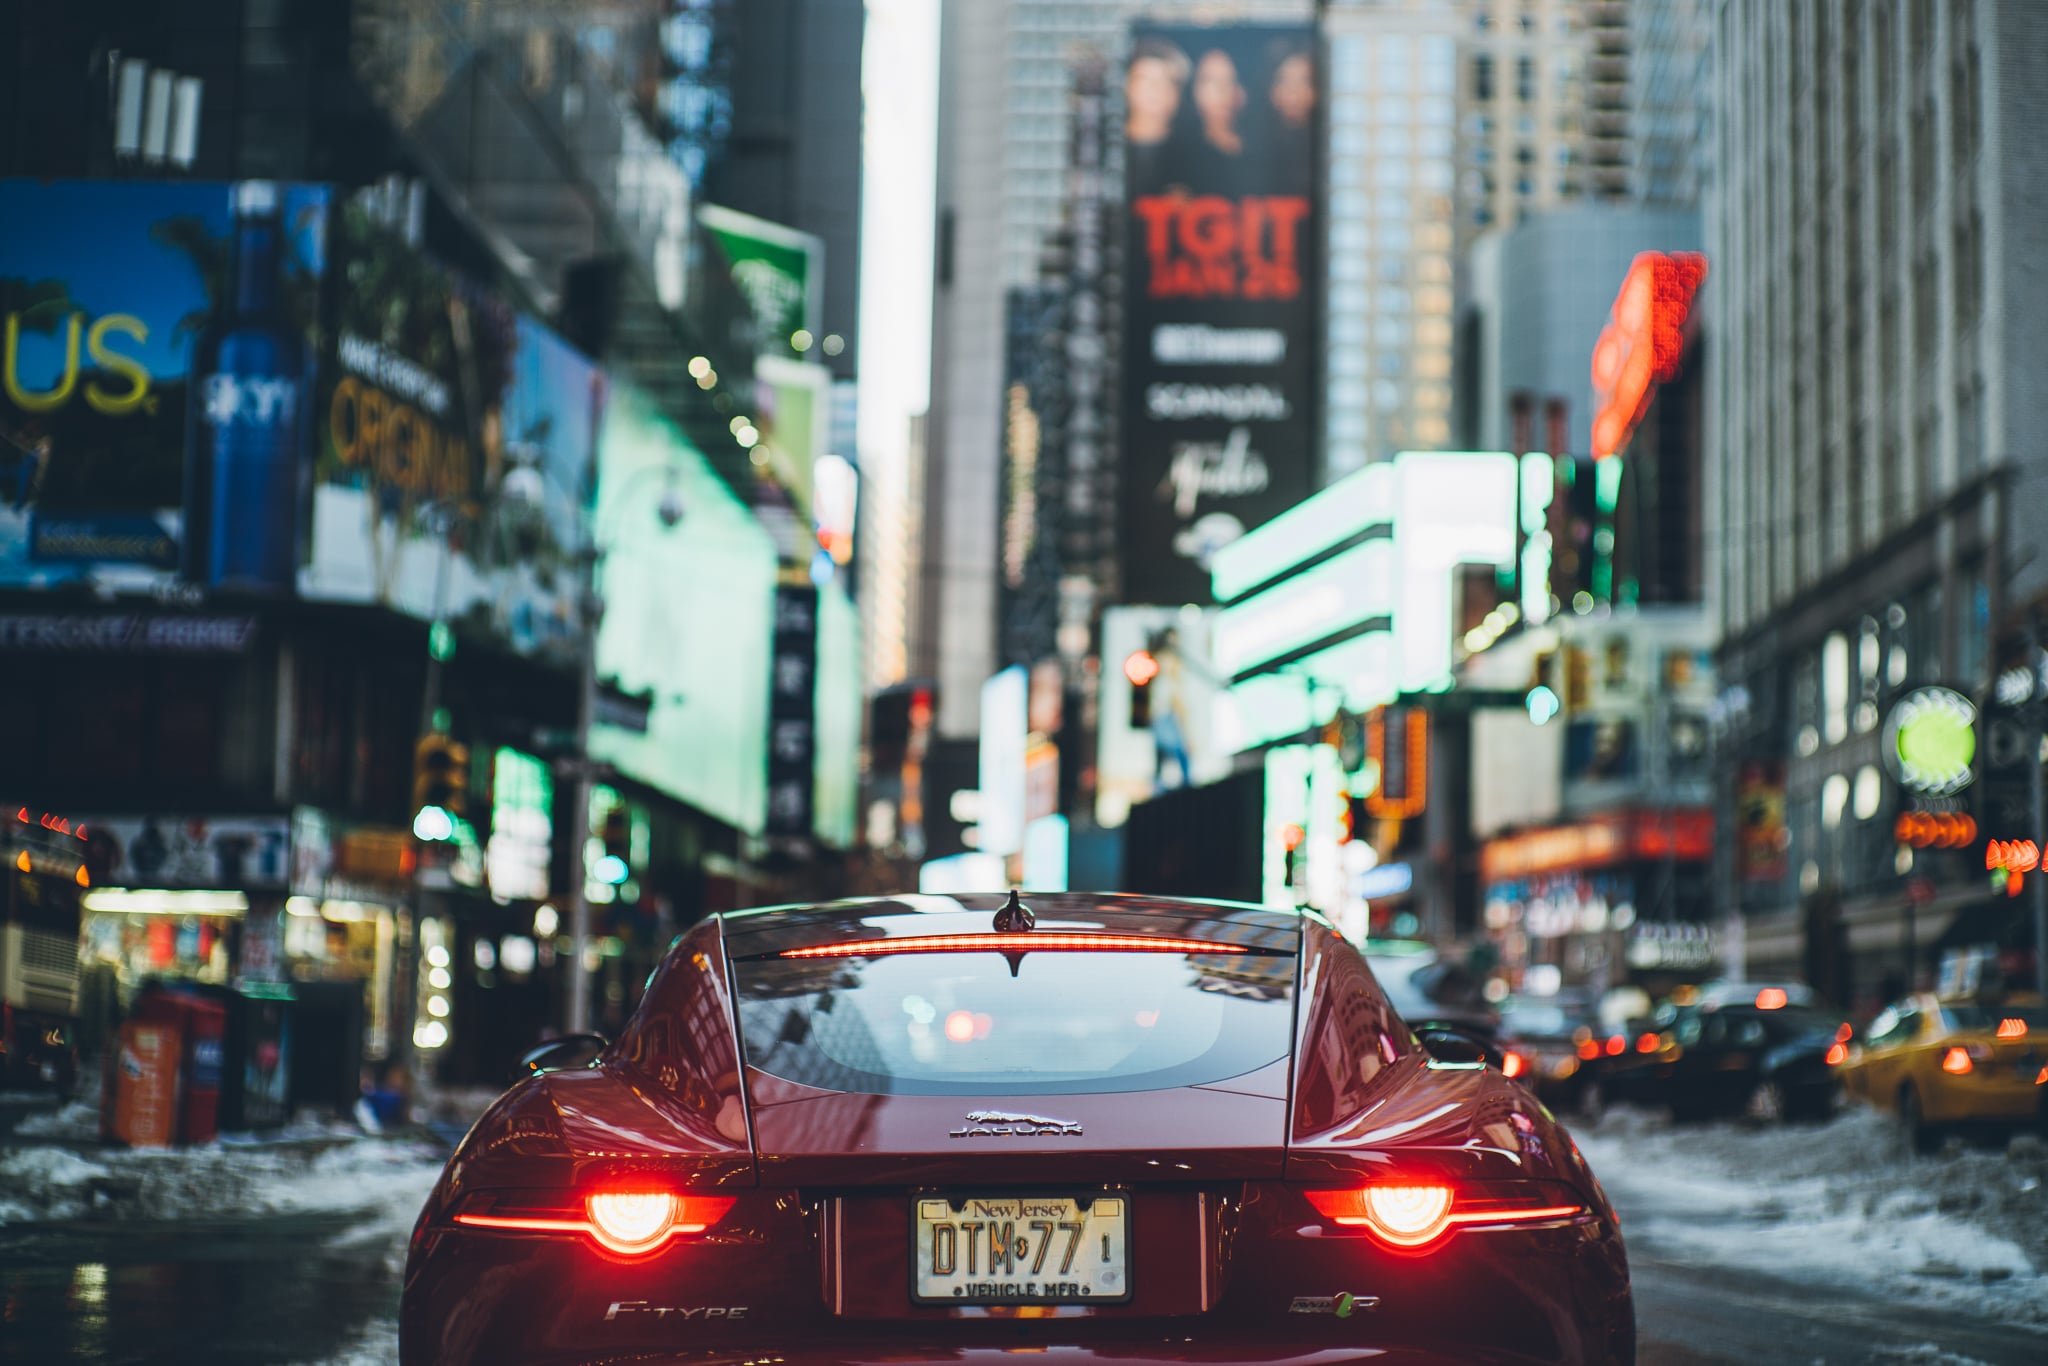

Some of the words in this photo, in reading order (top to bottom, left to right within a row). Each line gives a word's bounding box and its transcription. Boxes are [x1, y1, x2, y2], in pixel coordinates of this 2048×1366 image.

[949, 1126, 1083, 1138] JAGUAR
[973, 1201, 1012, 1218] New
[1015, 1201, 1068, 1220] Jersey
[966, 1283, 1035, 1297] VEHICLE
[1044, 1283, 1079, 1297] MFR
[603, 1300, 748, 1320] F-TYPE
